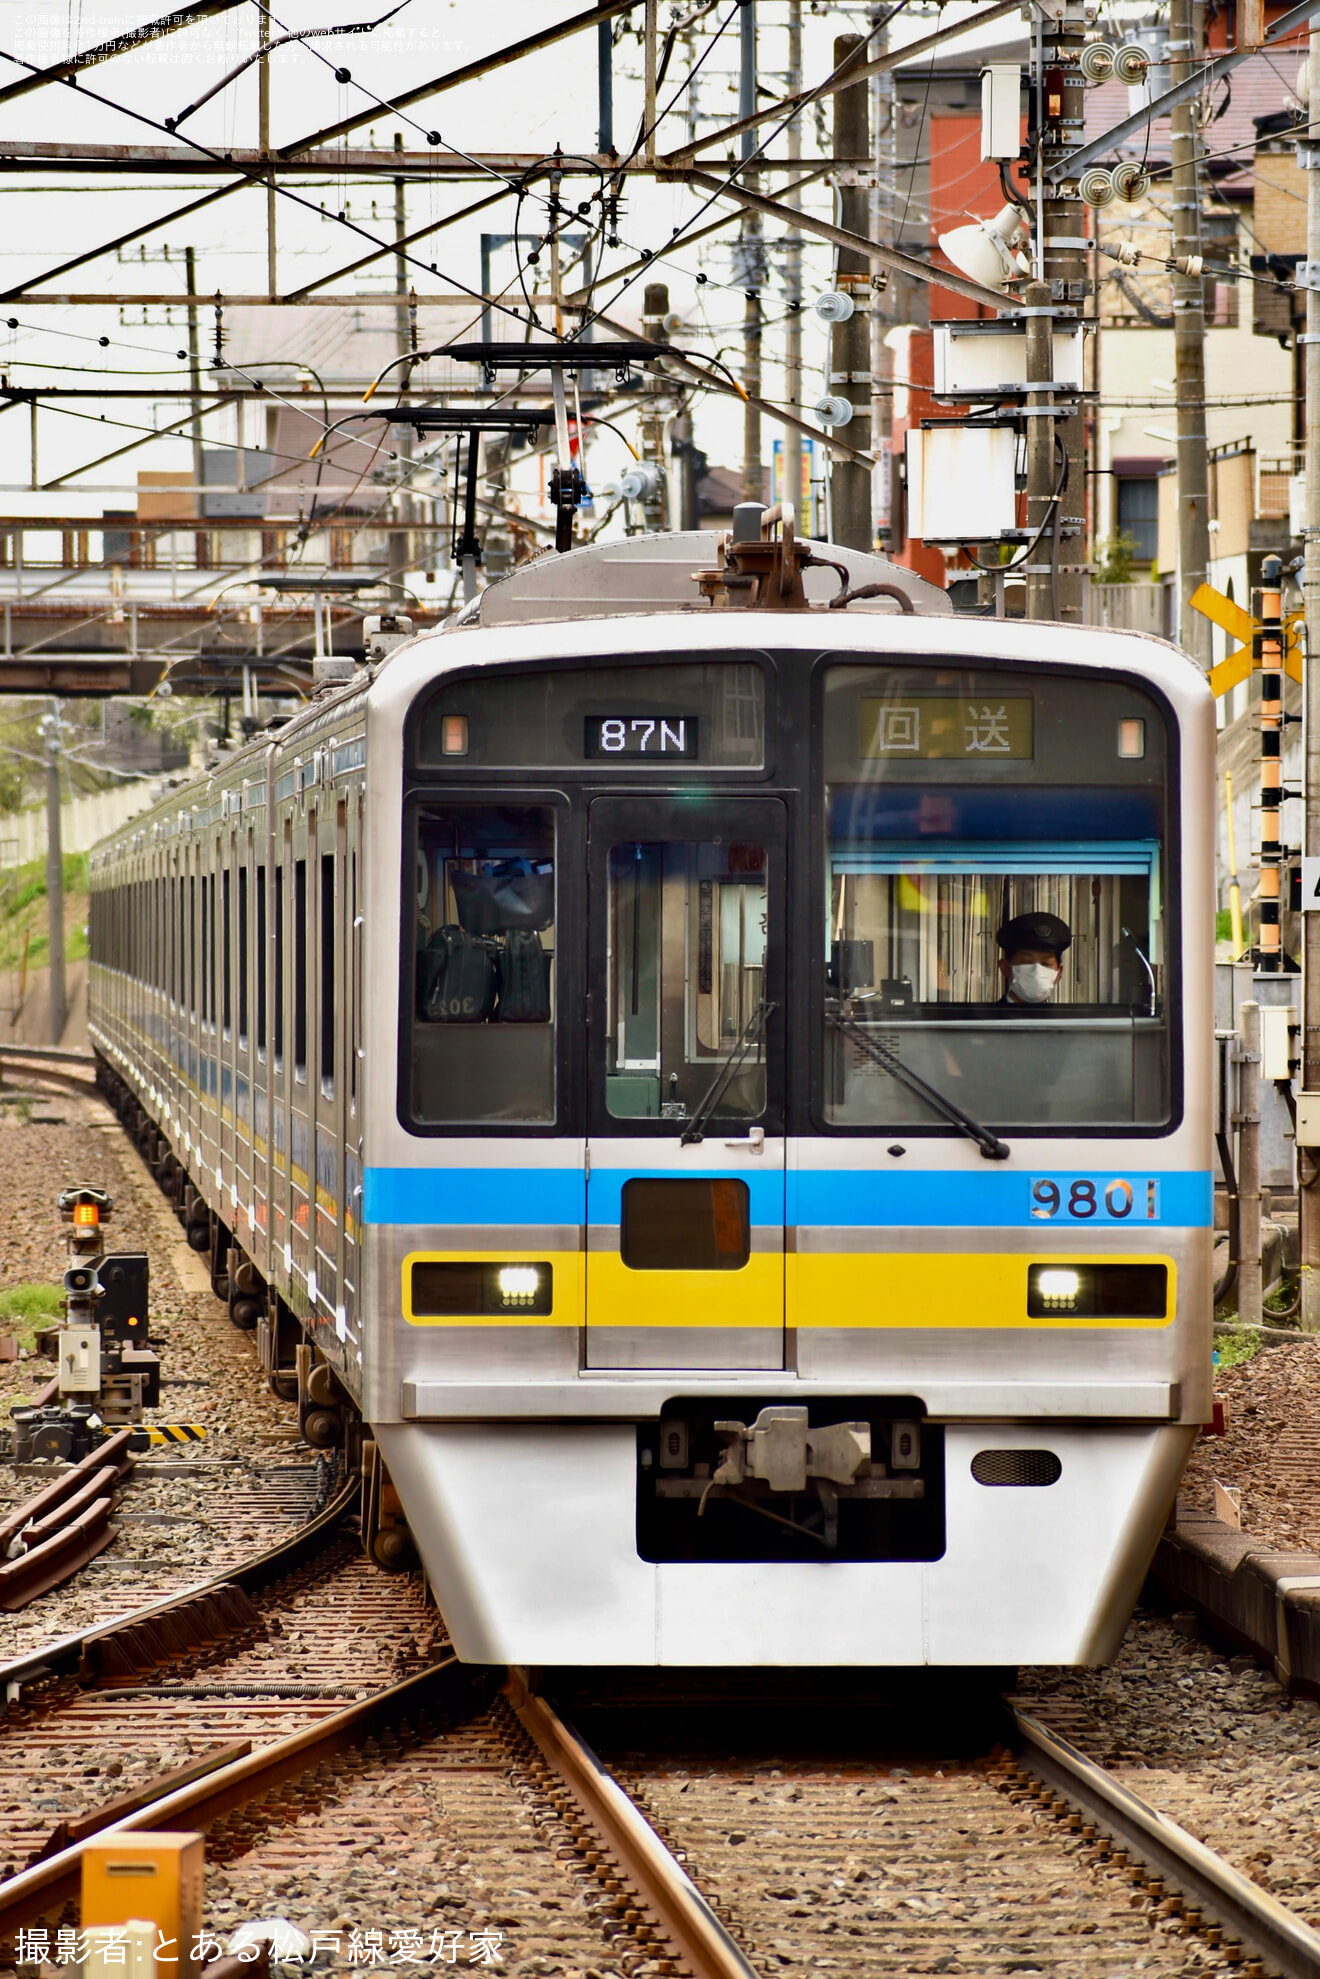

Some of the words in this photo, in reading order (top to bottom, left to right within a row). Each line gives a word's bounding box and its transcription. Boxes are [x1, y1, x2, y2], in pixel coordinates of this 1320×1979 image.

[602, 720, 684, 751] 87N
[879, 706, 1010, 751] 回送
[1032, 1179, 1154, 1218] 9801
